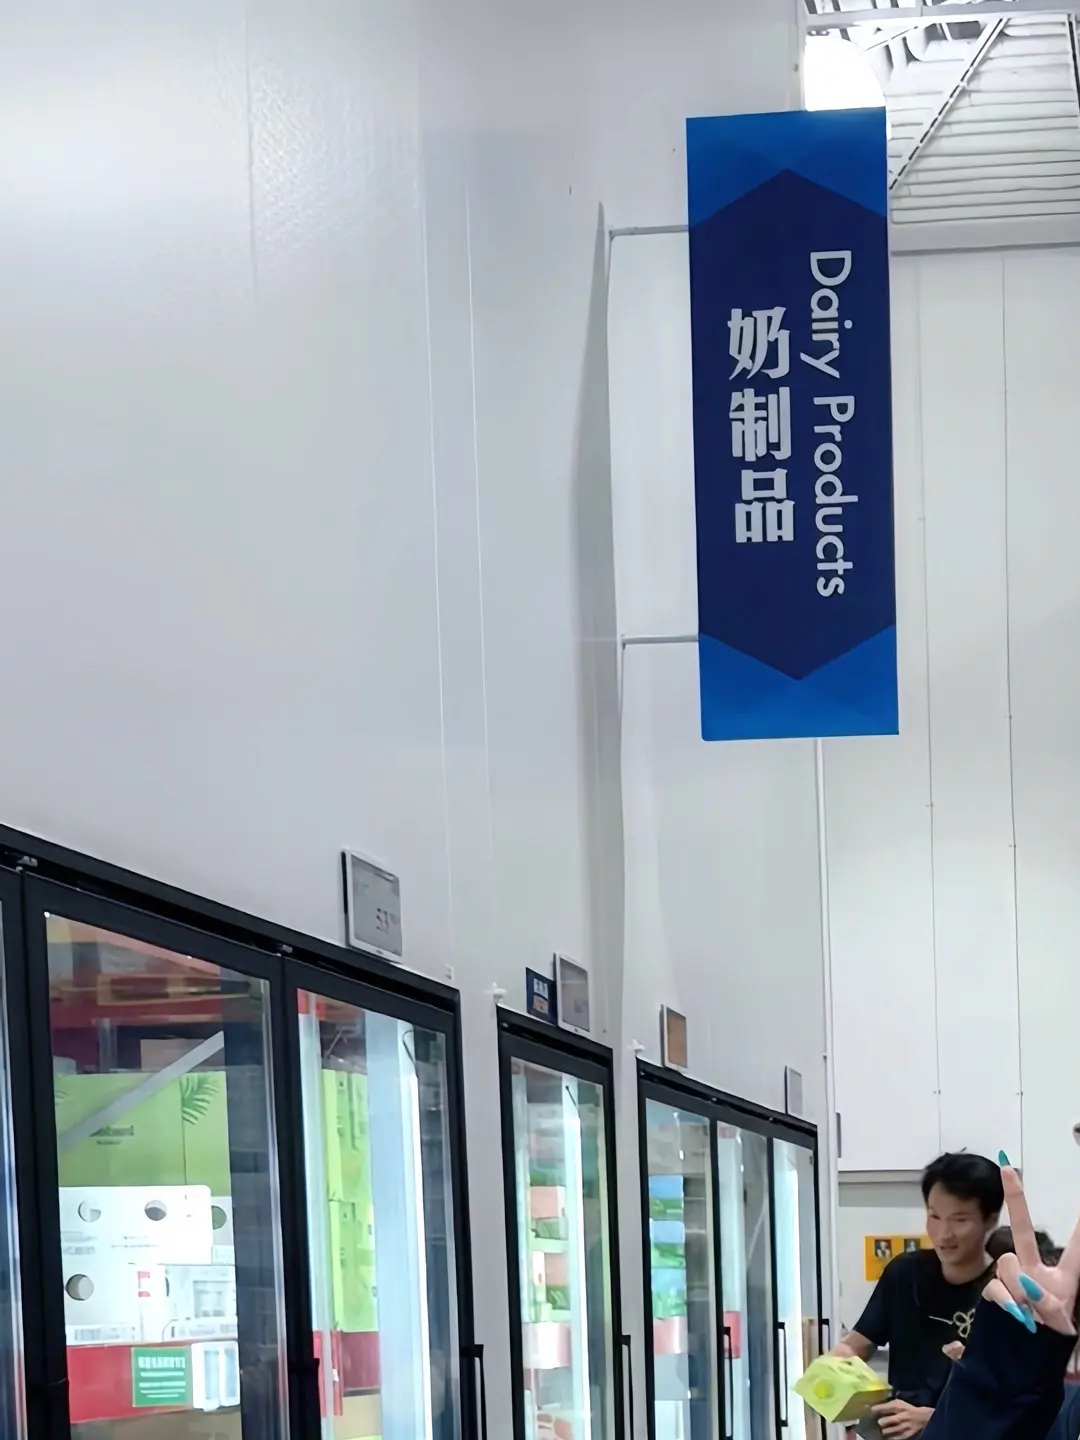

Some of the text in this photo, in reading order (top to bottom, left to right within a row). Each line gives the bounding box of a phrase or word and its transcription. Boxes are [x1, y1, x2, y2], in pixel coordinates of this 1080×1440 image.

[727, 305, 795, 544] 奶制品
[800, 249, 858, 597] Dairy Products
